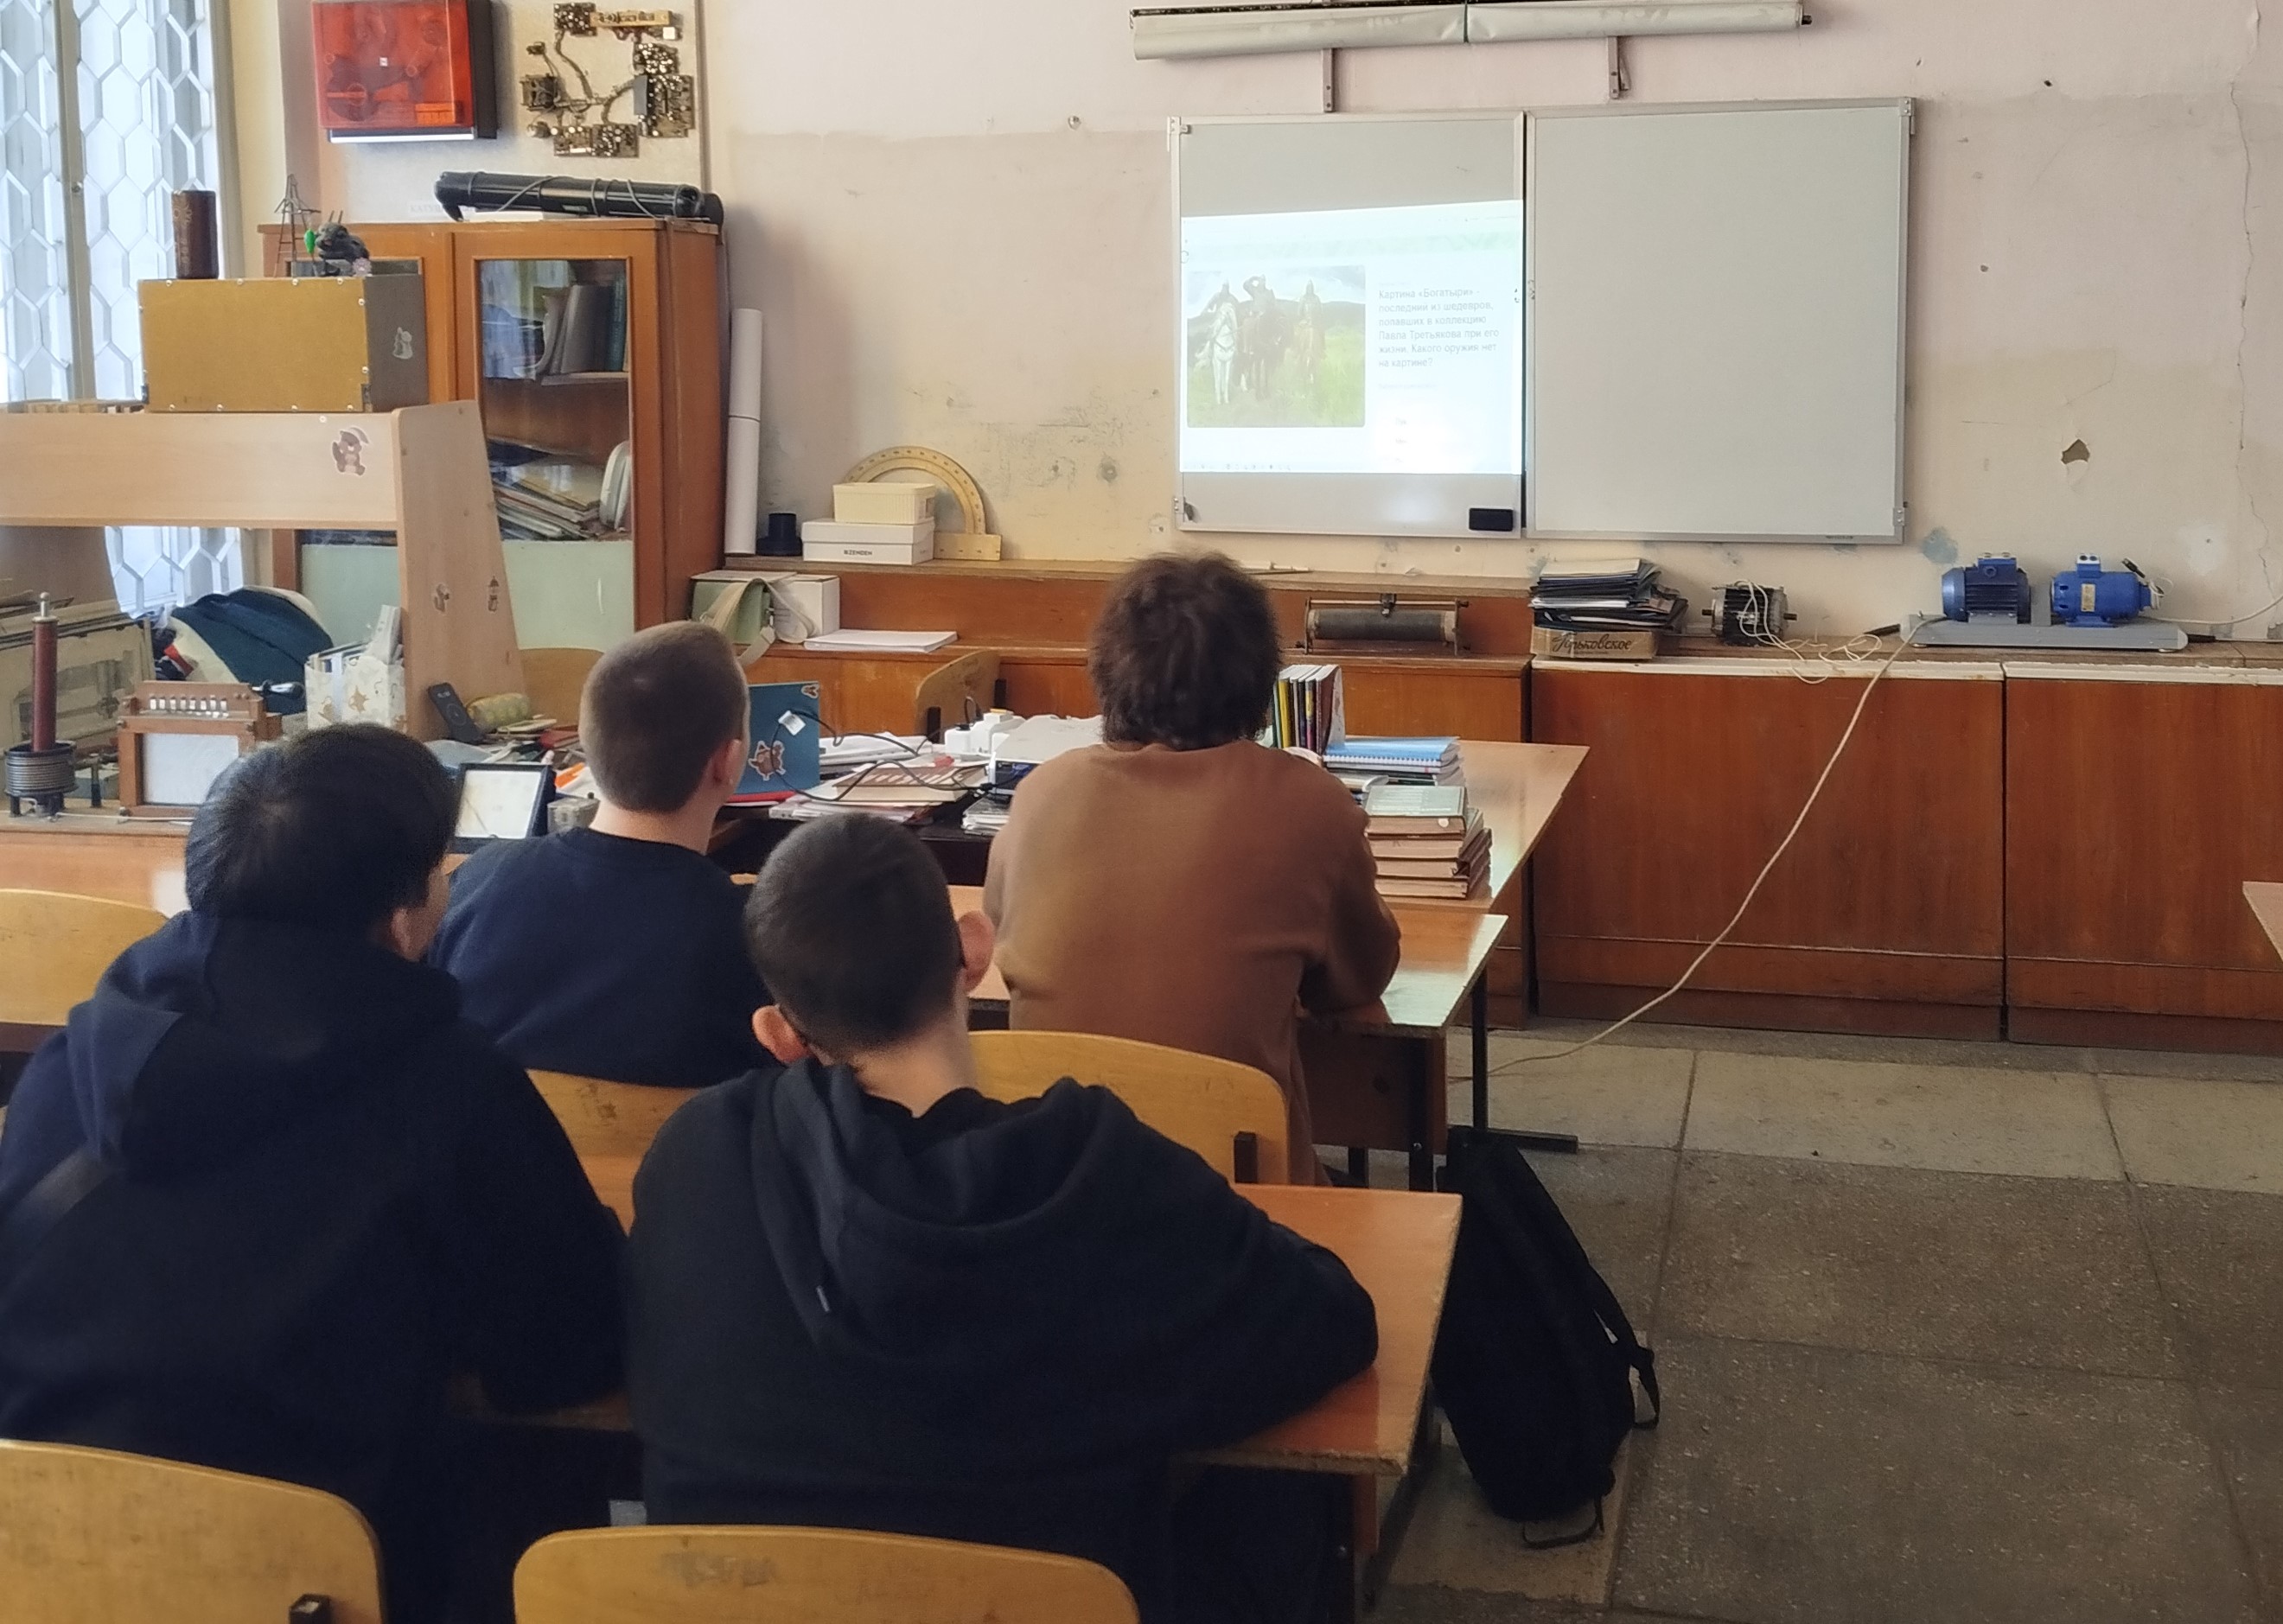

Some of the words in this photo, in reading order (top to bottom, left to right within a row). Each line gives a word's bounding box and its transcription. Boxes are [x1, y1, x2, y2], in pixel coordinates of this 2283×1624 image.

[1379, 290, 1416, 300] Картина
[1379, 318, 1425, 327] попавших
[1435, 315, 1486, 325] коллекцию
[1379, 330, 1406, 341] Павла
[1410, 330, 1462, 341] Третьякова
[1464, 329, 1482, 340] при
[1484, 329, 1500, 338] его
[1412, 344, 1442, 353] Какого
[1444, 345, 1479, 354] оружия
[1482, 343, 1497, 352] нет
[1392, 358, 1433, 369] картине?
